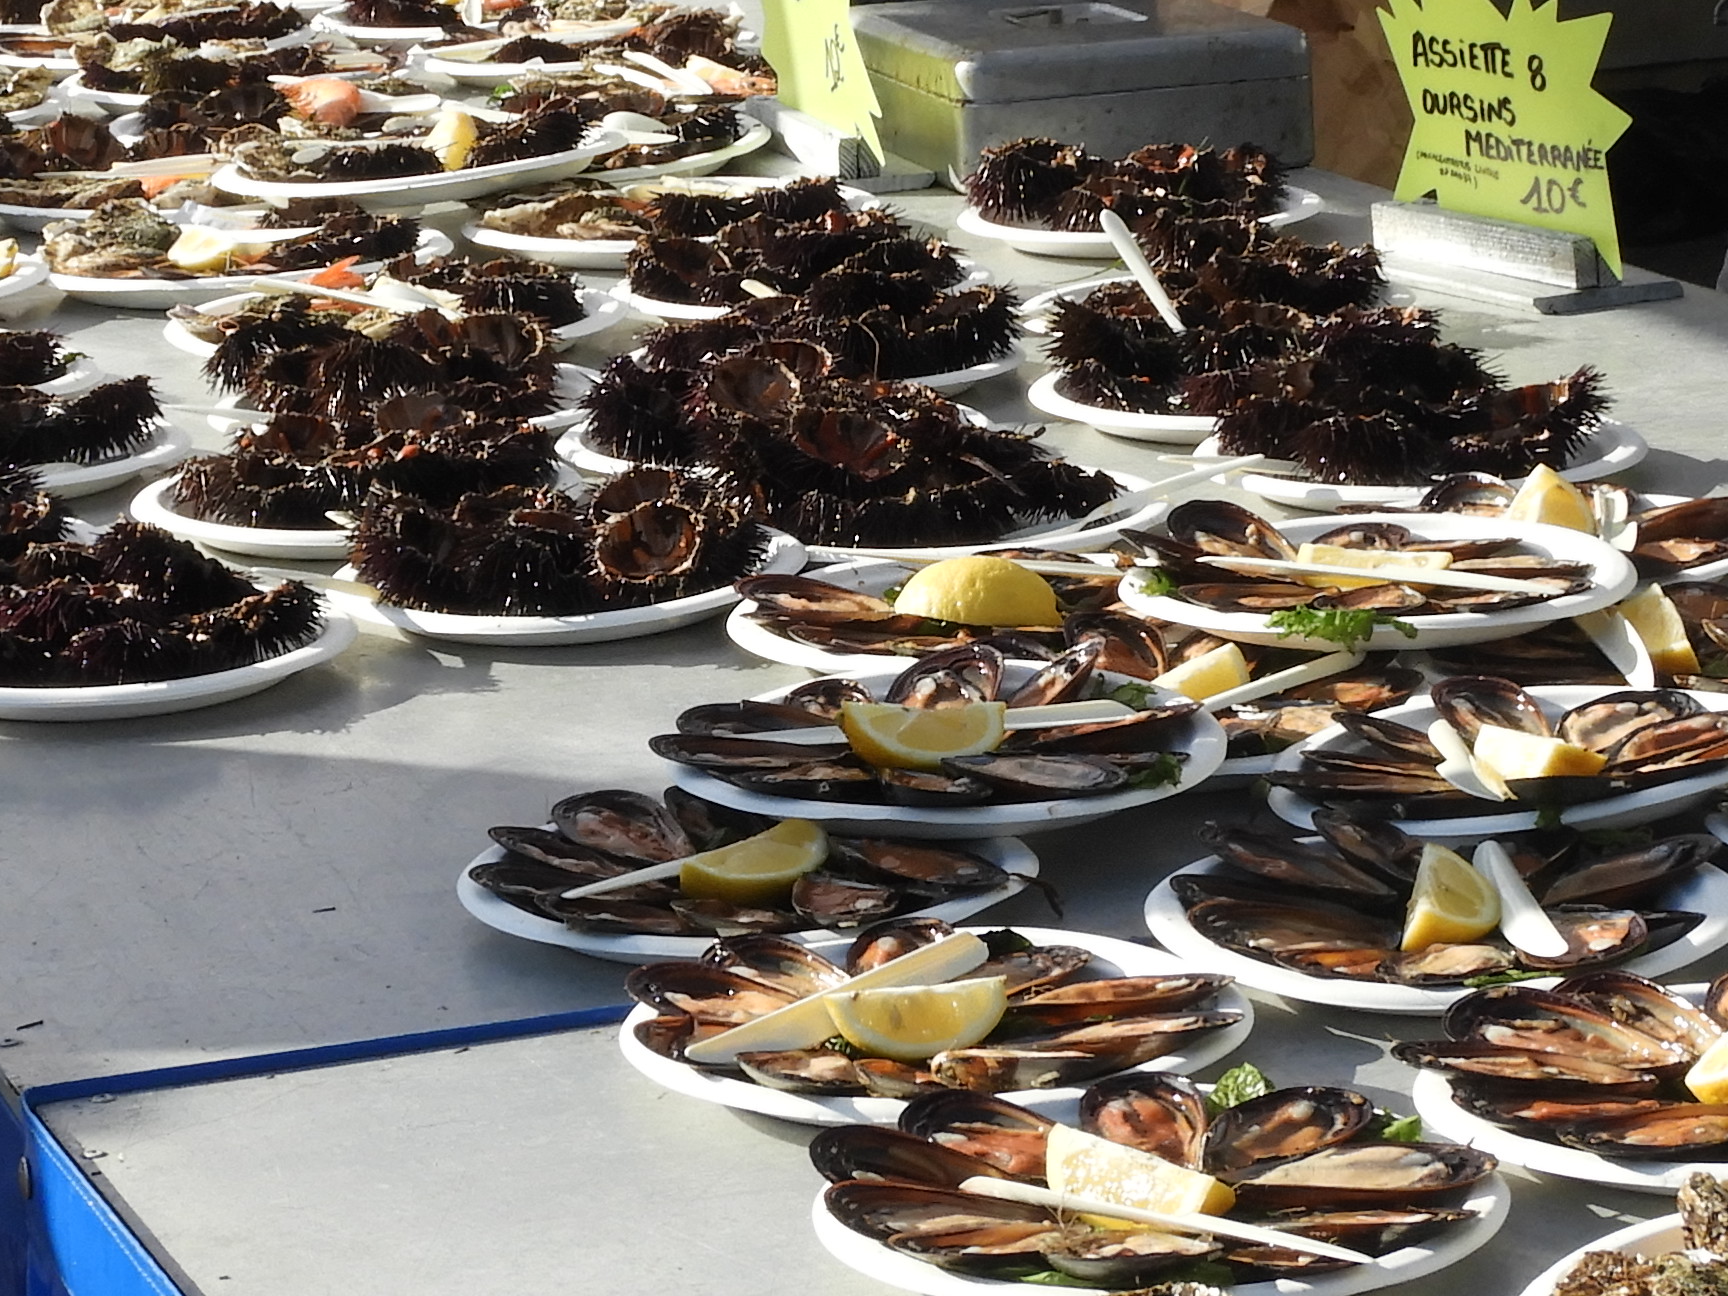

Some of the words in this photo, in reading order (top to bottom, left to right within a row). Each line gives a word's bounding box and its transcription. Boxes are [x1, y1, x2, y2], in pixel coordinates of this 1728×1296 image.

[1527, 55, 1547, 92] 8
[1422, 88, 1516, 128] OURSINS
[1519, 175, 1588, 214] 10€
